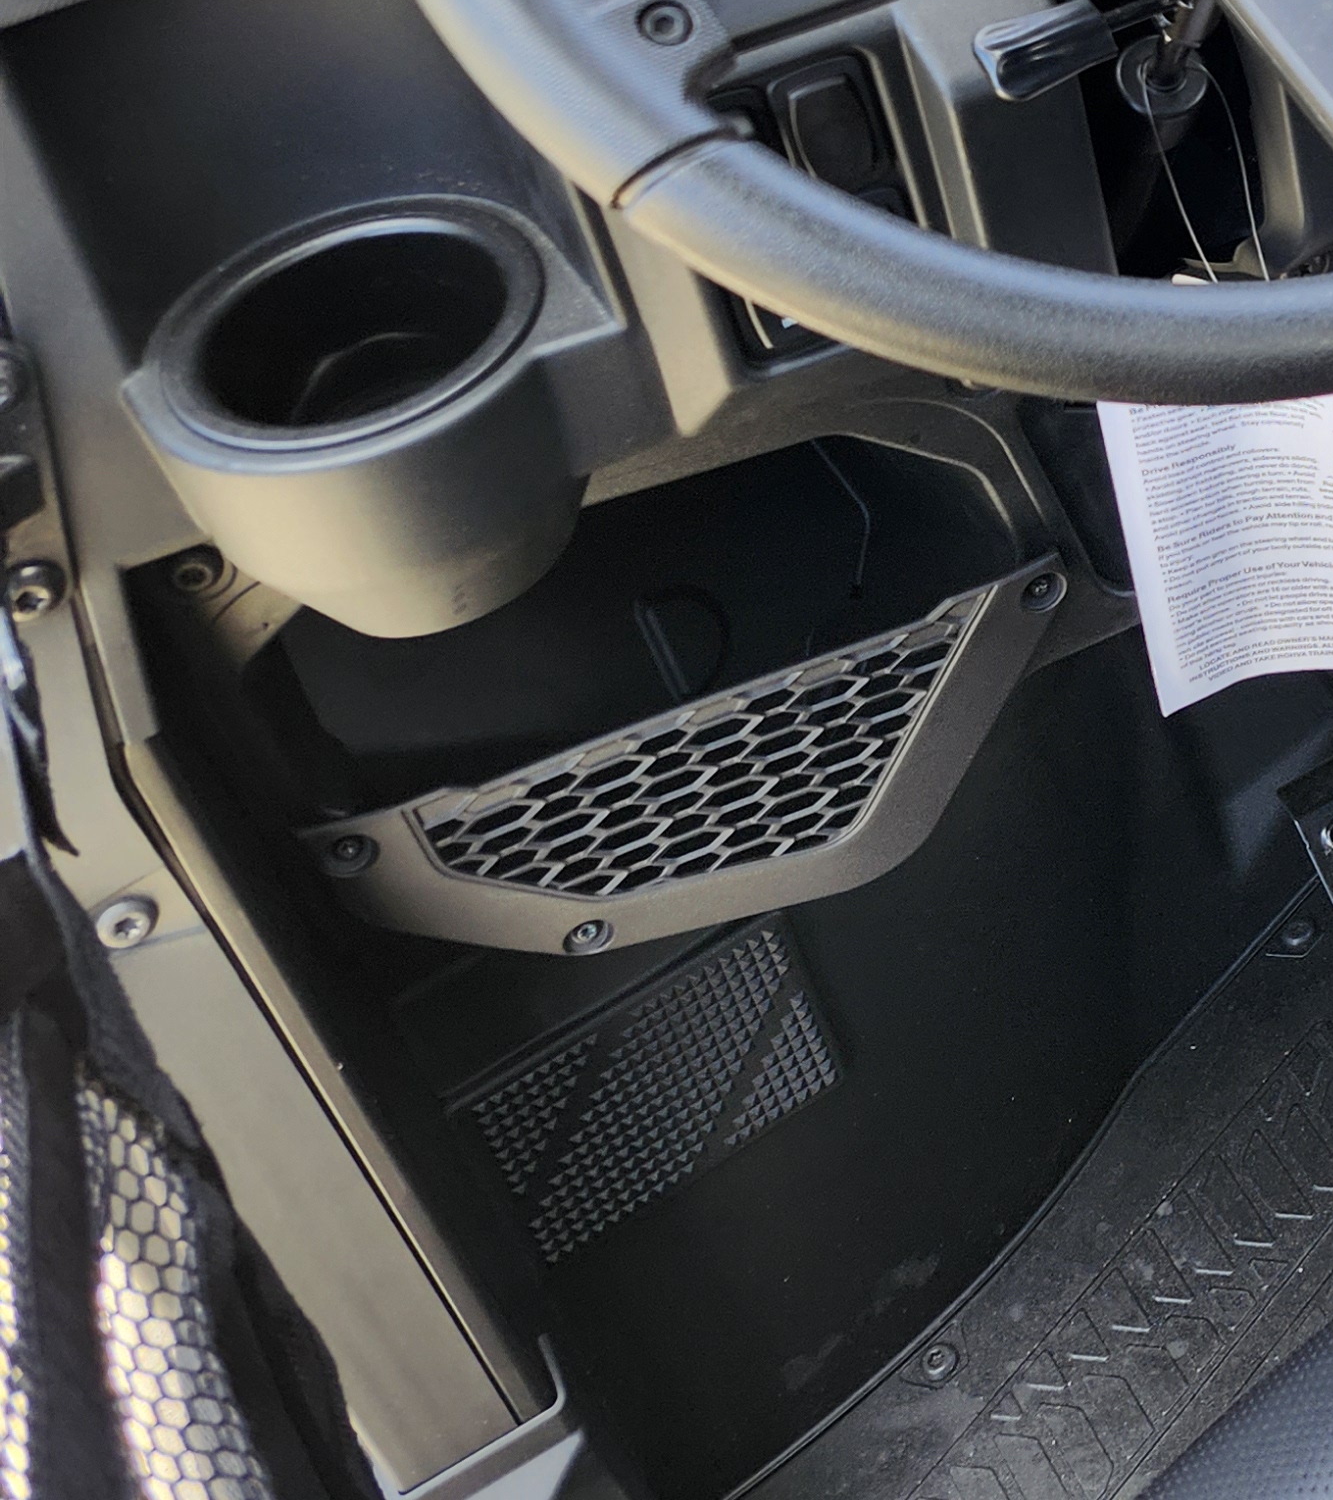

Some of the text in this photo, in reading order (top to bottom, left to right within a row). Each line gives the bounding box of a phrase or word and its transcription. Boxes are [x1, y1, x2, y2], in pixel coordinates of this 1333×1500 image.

[1141, 444, 1236, 477] Drive Responsibly
[1167, 584, 1207, 604] Require
[1208, 569, 1241, 587] Proper
[1243, 565, 1264, 574] Use
[1265, 562, 1276, 570] of
[1276, 561, 1301, 569] Your
